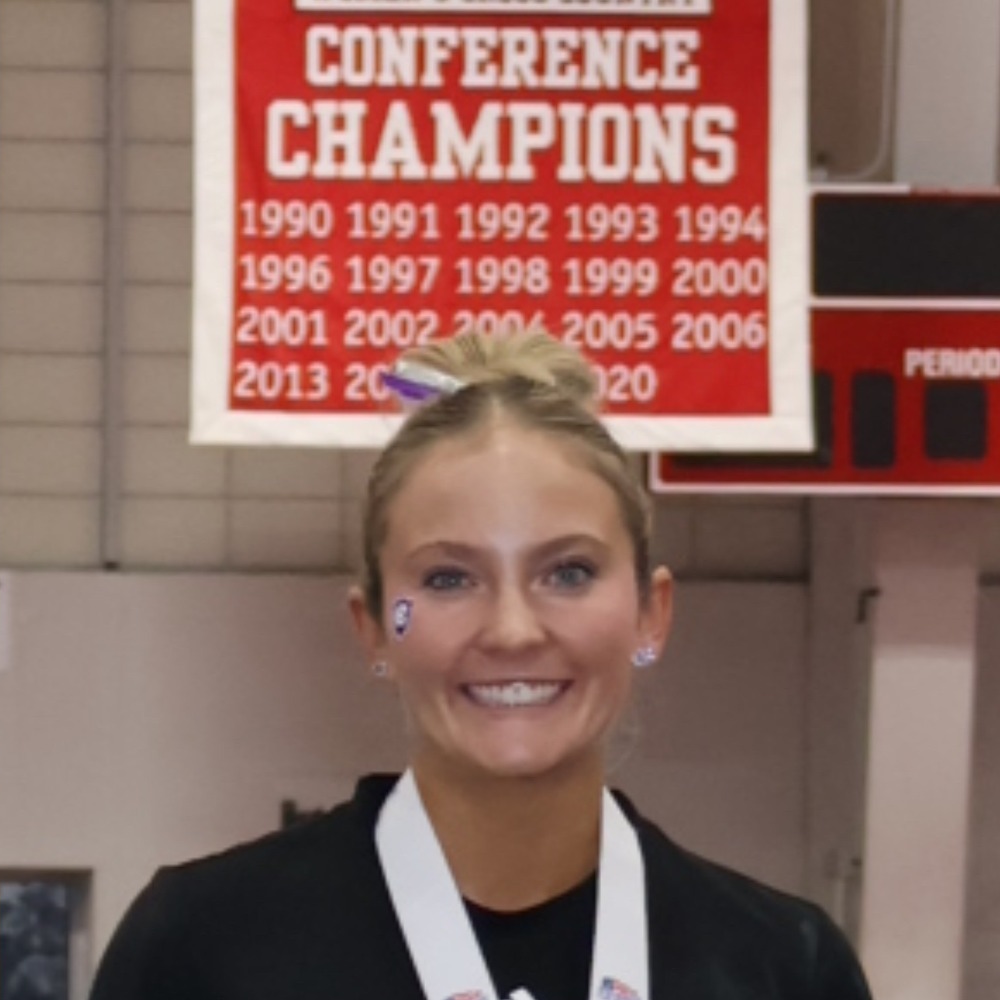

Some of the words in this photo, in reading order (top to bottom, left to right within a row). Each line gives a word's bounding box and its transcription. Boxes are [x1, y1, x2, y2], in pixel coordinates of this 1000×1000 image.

[304, 24, 701, 91] CONFERENCE
[265, 99, 737, 184] CHAMPIONS
[240, 200, 333, 239] 1990
[347, 201, 440, 240] 1991
[456, 202, 551, 241] 1992
[565, 203, 659, 243] 1993
[676, 205, 767, 243] 1994
[239, 253, 332, 293] 1996
[346, 254, 441, 294] 1997
[456, 256, 551, 295] 1998
[564, 257, 659, 296] 1999
[671, 258, 767, 296] 2000
[236, 307, 328, 346] 2001
[344, 309, 439, 346] 2002
[562, 310, 658, 349] 2005
[671, 312, 767, 350] 2006
[234, 361, 329, 400] 2013
[904, 348, 1000, 378] PERIOD
